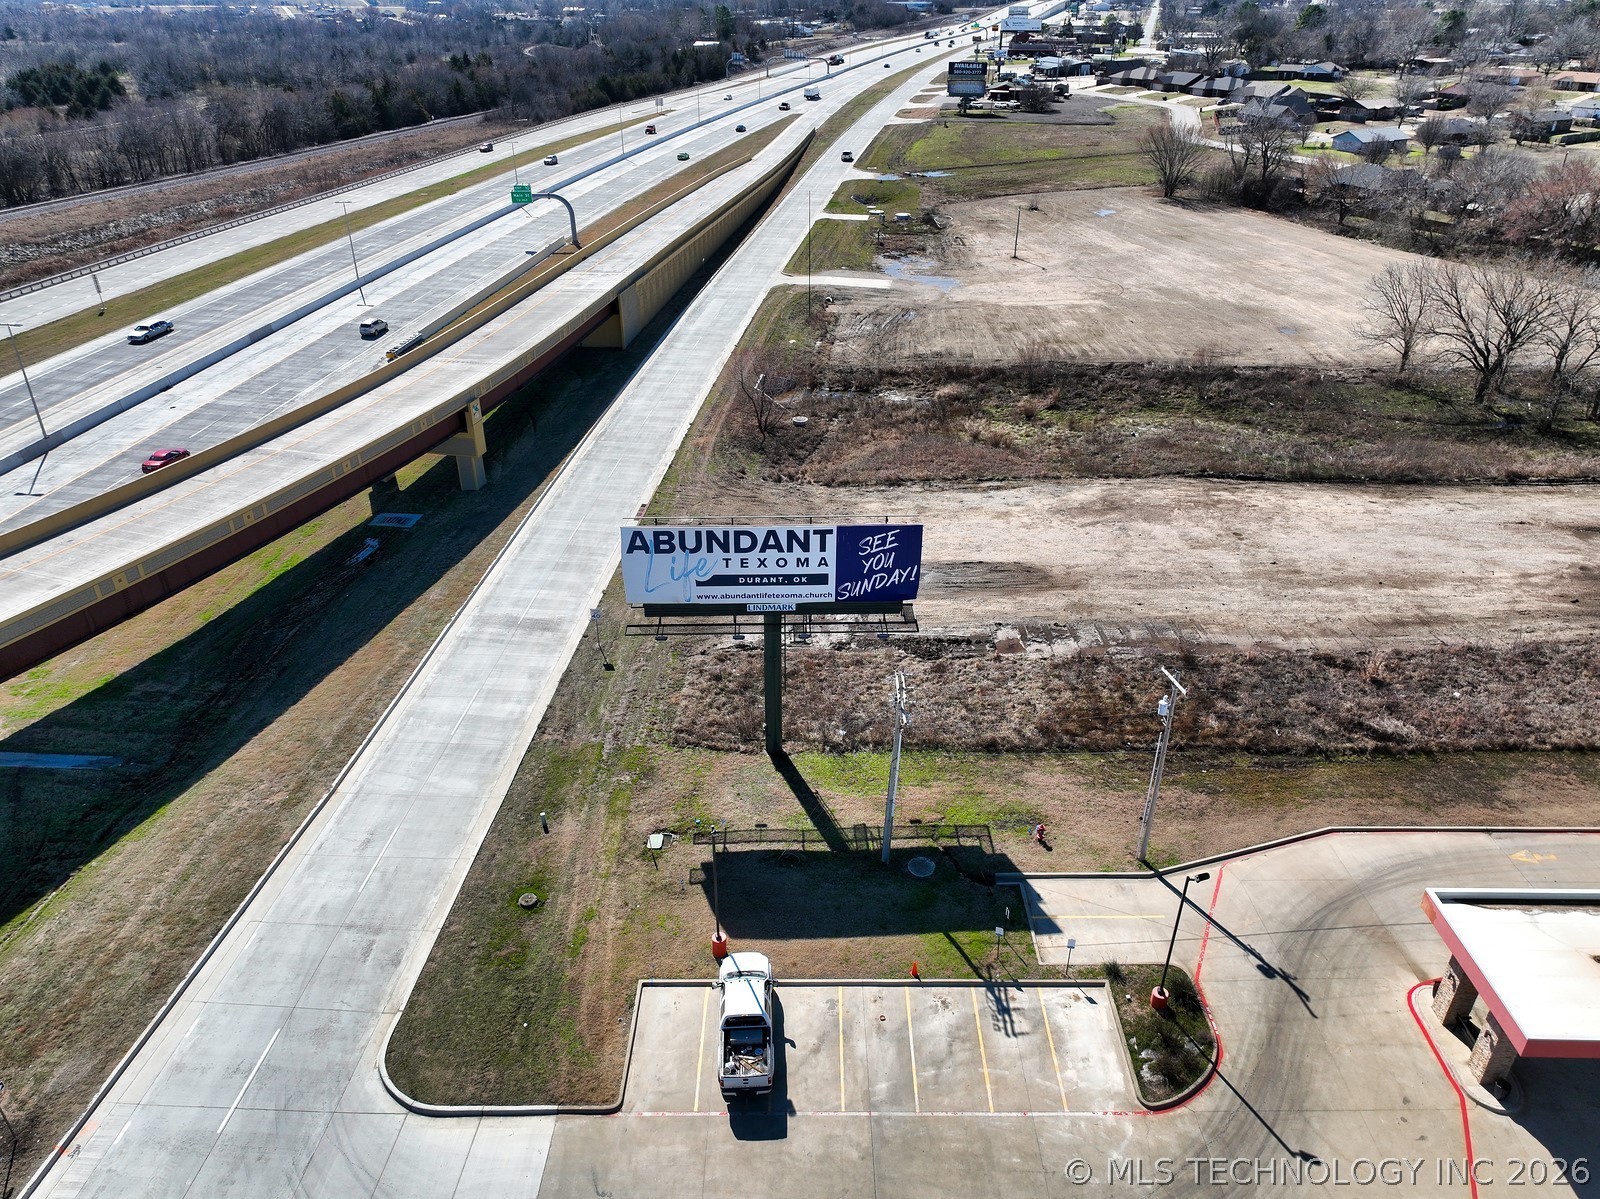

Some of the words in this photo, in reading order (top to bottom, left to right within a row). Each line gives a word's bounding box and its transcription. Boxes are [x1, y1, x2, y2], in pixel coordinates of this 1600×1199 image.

[626, 529, 833, 554] ABUNDANT
[858, 529, 900, 555] SEE
[644, 539, 719, 602] Life
[722, 556, 829, 568] TEXOMA
[862, 551, 896, 574] YOU
[837, 564, 918, 600] SUNDAY!
[696, 591, 833, 600] www.abundantlifetexoma.church
